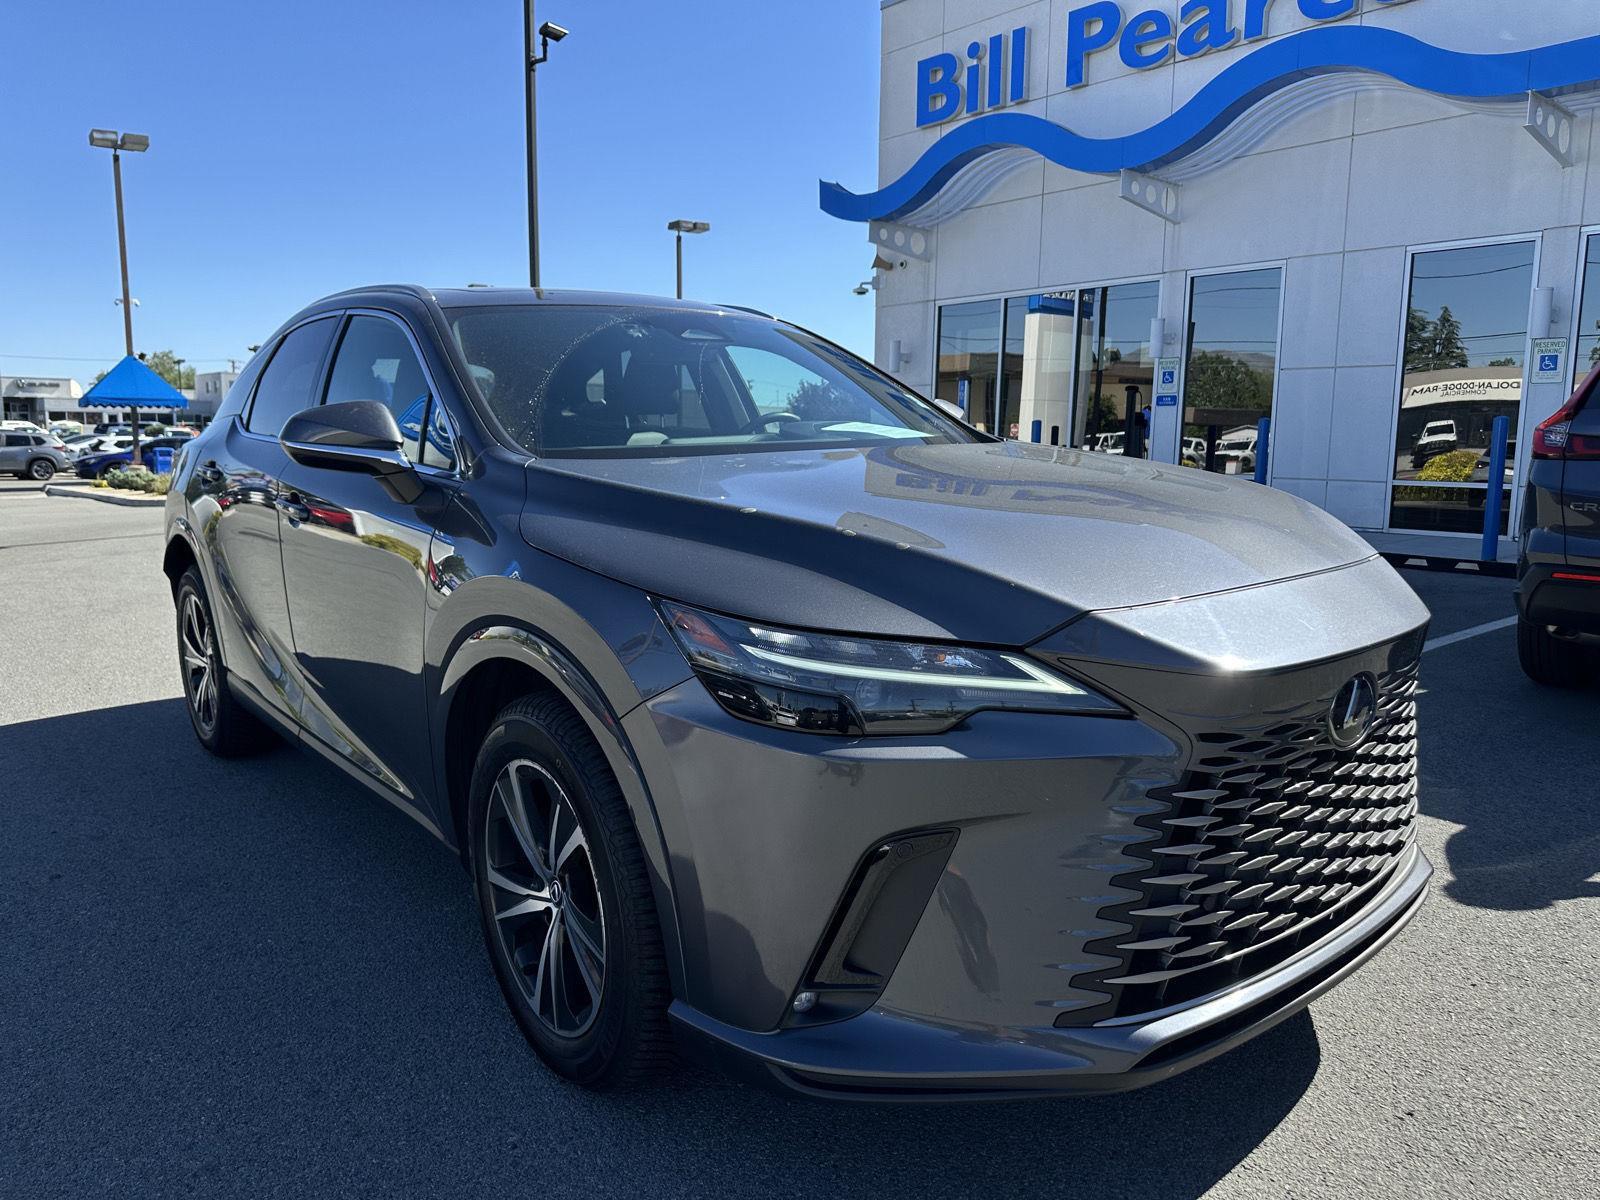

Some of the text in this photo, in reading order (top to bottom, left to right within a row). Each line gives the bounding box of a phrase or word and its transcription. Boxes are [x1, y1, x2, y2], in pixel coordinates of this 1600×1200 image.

[916, 0, 1413, 128] Bill Pear
[1535, 340, 1566, 349] RESERVED
